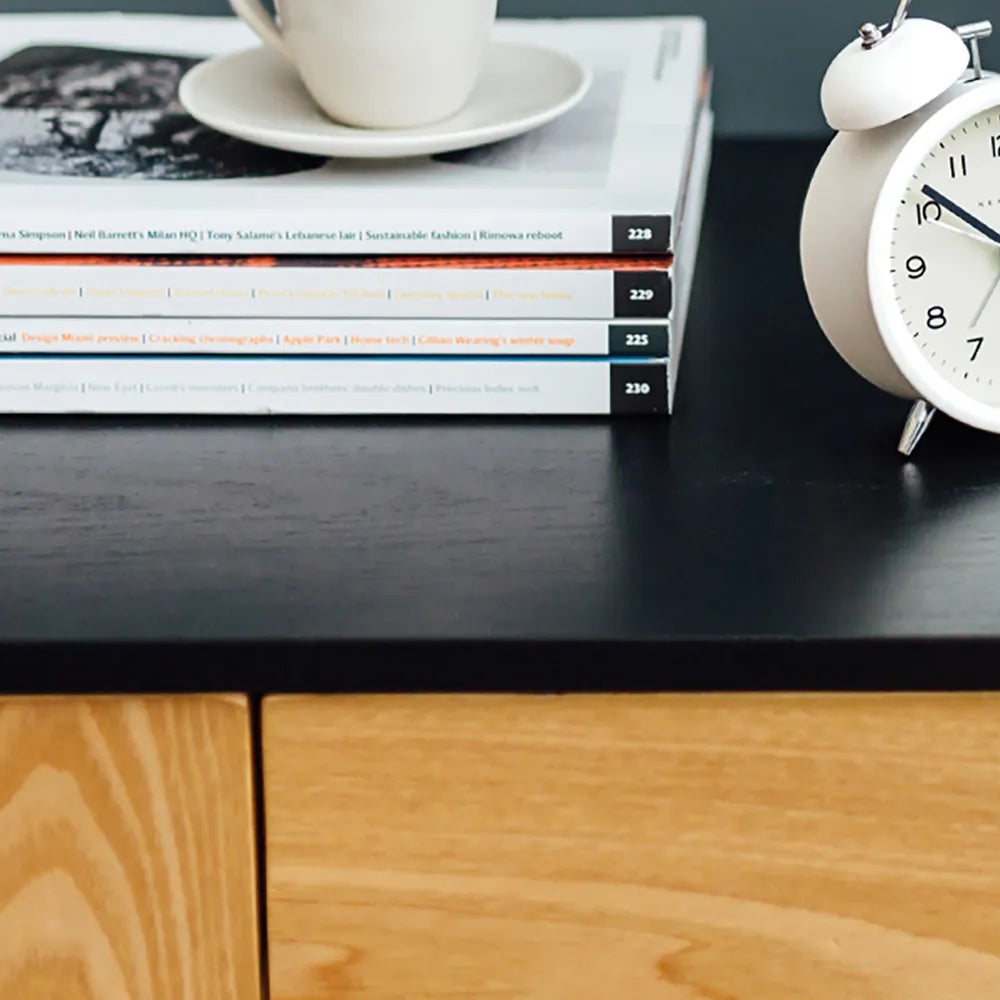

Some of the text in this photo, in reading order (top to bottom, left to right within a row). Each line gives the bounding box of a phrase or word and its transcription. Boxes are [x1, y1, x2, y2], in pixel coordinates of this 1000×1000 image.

[950, 154, 967, 178] 11
[916, 201, 942, 226] 10
[19, 230, 66, 241] Simpson
[75, 230, 95, 240] Neil
[147, 230, 177, 240] Milan
[179, 230, 198, 242] HQ
[207, 230, 233, 242] Tony
[366, 230, 428, 240] Sustainable
[431, 230, 471, 240] fashion
[479, 230, 524, 240] Rimowa
[526, 230, 563, 240] reboot
[628, 228, 652, 240] 228
[905, 255, 927, 279] 9
[630, 289, 653, 301] 229
[926, 305, 947, 330] 8
[283, 335, 313, 345] Apple
[317, 335, 341, 344] Park
[625, 334, 649, 345] 225
[966, 337, 984, 361] 7
[625, 383, 650, 394] 230
